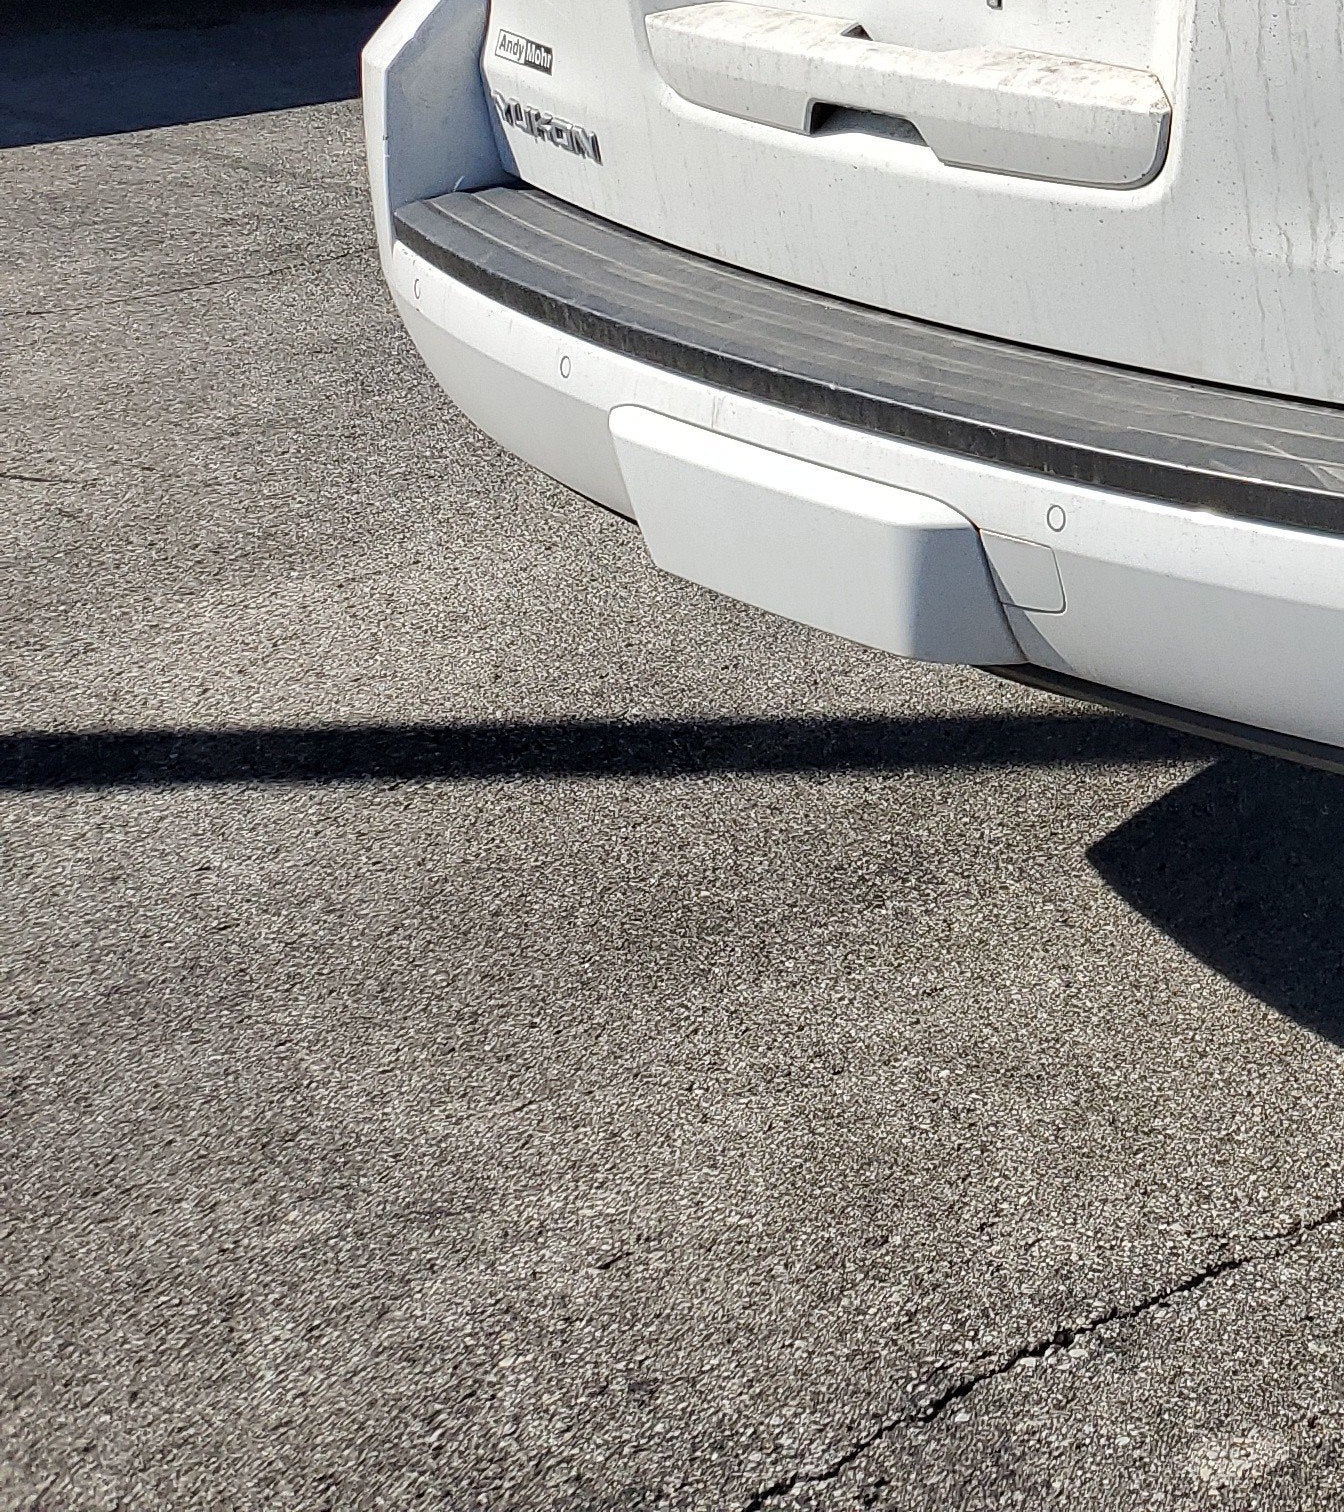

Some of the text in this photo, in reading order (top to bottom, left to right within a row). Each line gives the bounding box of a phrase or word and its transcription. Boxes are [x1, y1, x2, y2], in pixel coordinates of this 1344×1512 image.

[498, 33, 553, 69] Andy Mohr
[491, 90, 604, 166] YUKON
